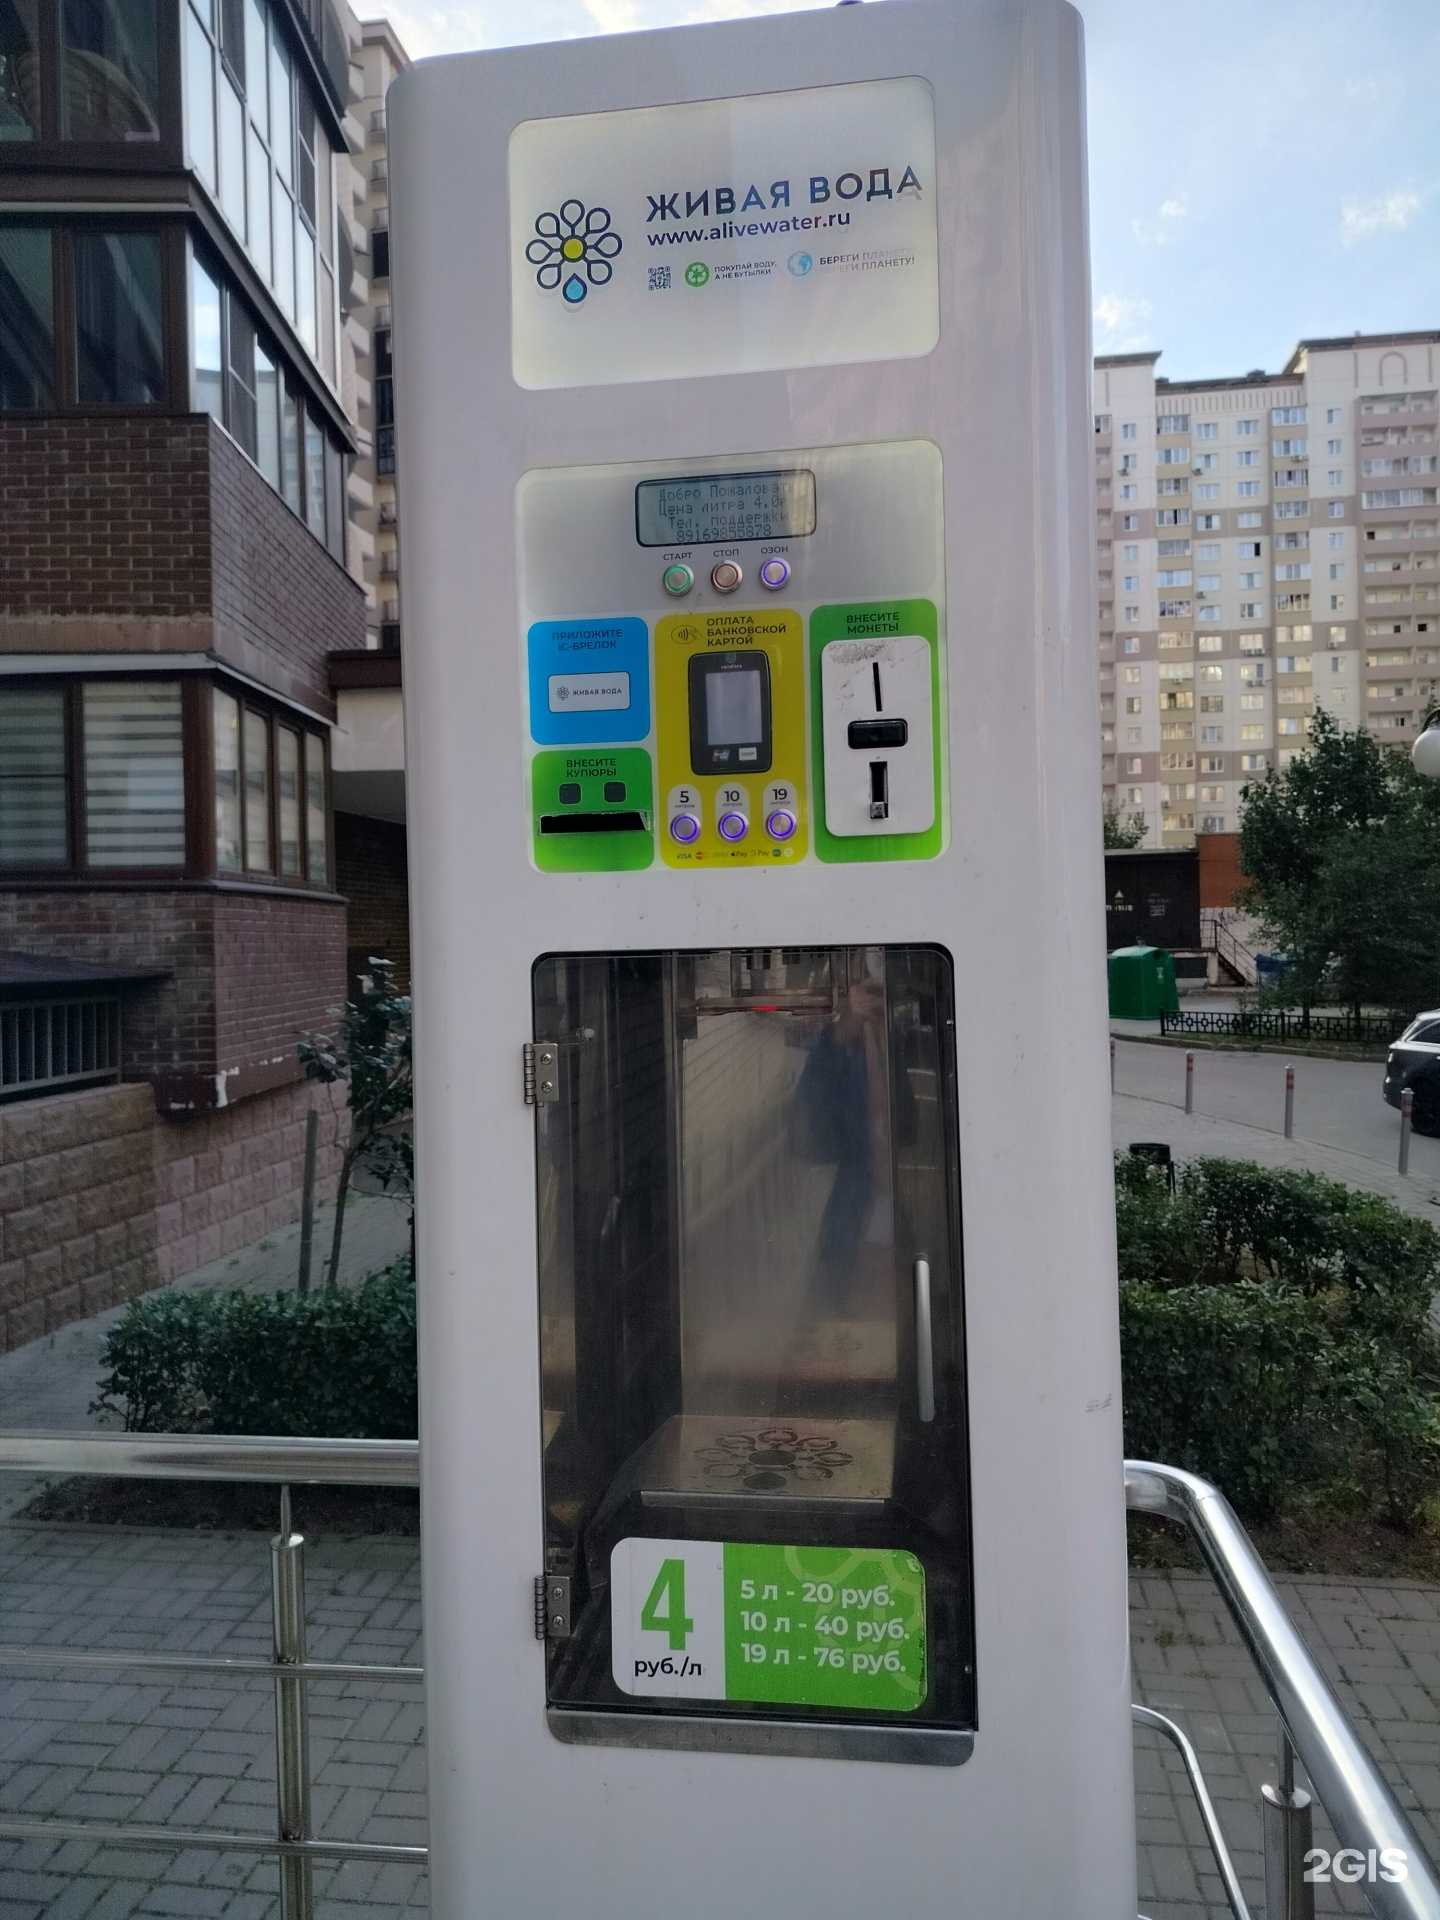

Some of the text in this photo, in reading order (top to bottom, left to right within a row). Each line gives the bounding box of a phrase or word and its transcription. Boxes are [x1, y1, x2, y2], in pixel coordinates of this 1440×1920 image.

[646, 165, 922, 222] ЖИВАЯ ВОДА
[647, 212, 850, 246] www.alivewater.ru
[819, 253, 860, 265] БЕРЕГИ
[714, 262, 752, 272] ПОКУПАЙ
[713, 548, 739, 557] СТОП
[760, 545, 789, 555] ОЗОН
[663, 552, 693, 561] СТАРТ
[706, 616, 754, 626] ОПЛАТА
[846, 611, 901, 624] ВНЕСИТЕ
[552, 629, 624, 640] ПРИЛОЖИТЕ
[706, 624, 787, 637] БАНКОВСКОЙ
[847, 623, 899, 634] МОНЕТЫ
[707, 635, 753, 647] КАРТОЙ
[566, 758, 617, 768] ВНЕСИТЕ
[566, 768, 617, 778] КУПЮРЫ
[680, 790, 689, 803] 5
[724, 790, 740, 802] 10
[772, 788, 788, 800] 19
[741, 1579, 755, 1600] 5
[761, 1584, 778, 1601] л
[802, 1583, 833, 1605] 20
[841, 1585, 896, 1610] руб.
[641, 1558, 694, 1651] 4
[741, 1612, 767, 1632] 10
[773, 1617, 791, 1633] л
[815, 1616, 848, 1637] 40
[856, 1617, 910, 1643] руб.
[741, 1643, 767, 1664] 19
[773, 1649, 790, 1666] л
[813, 1647, 845, 1669] 76
[853, 1650, 906, 1676] руб.
[634, 1656, 702, 1677] руб./л
